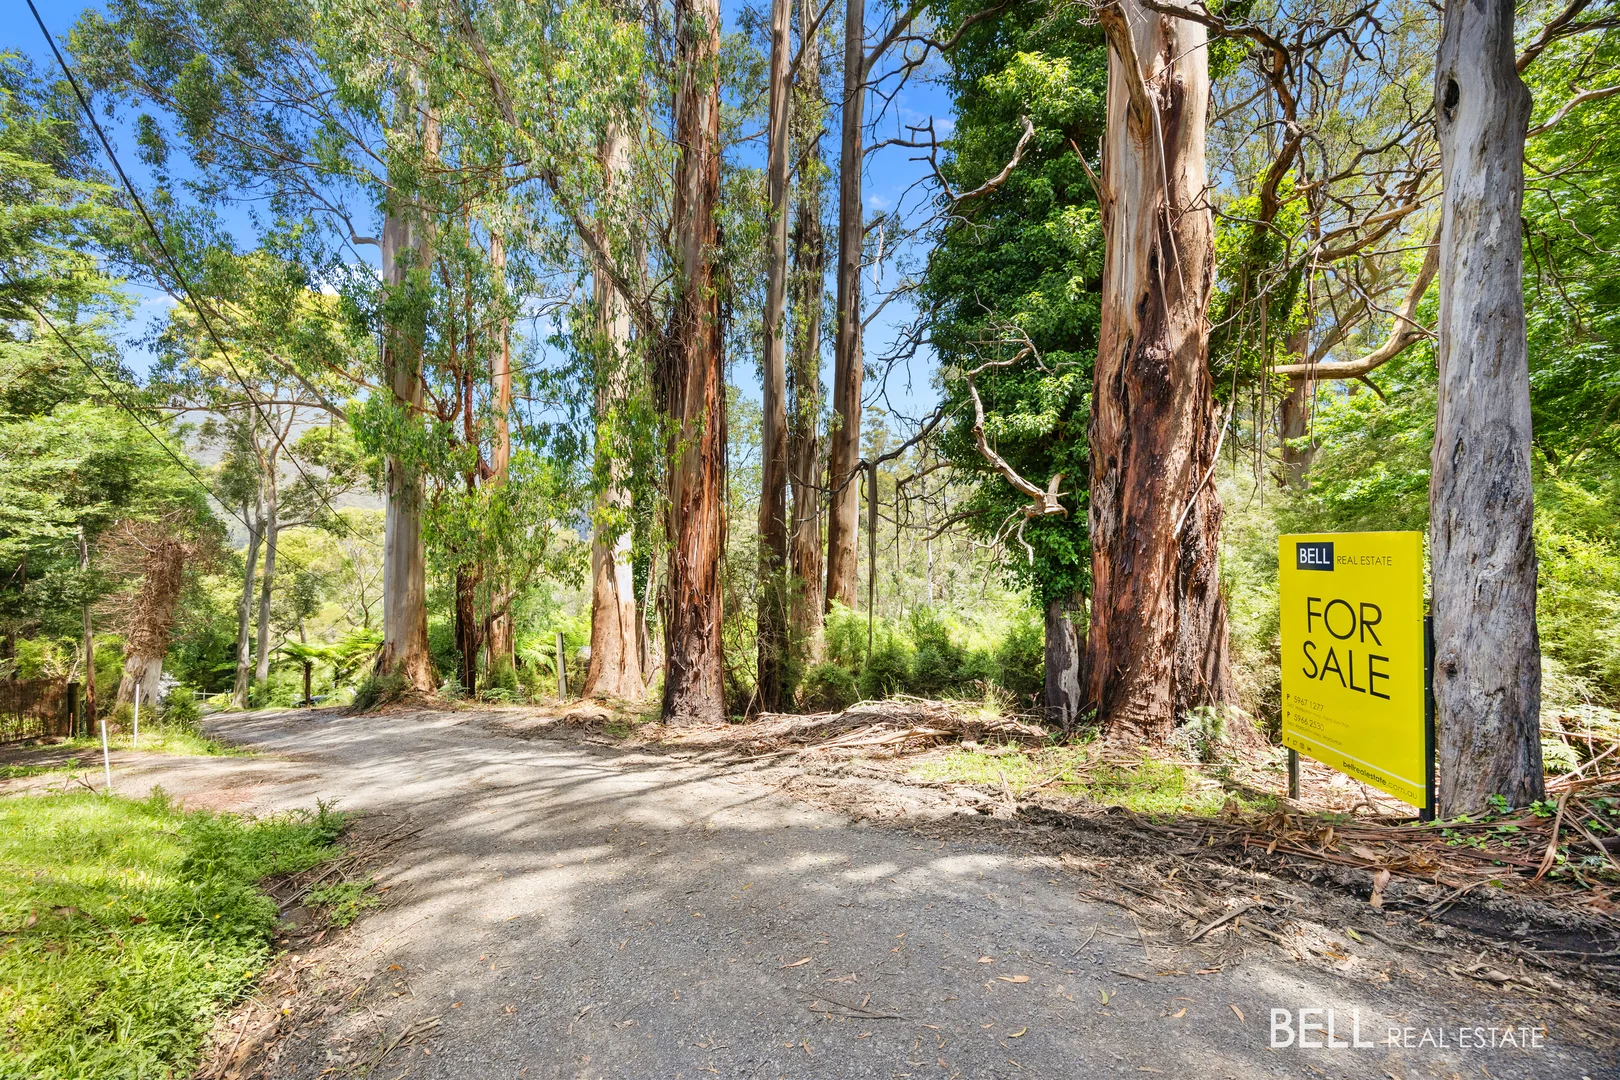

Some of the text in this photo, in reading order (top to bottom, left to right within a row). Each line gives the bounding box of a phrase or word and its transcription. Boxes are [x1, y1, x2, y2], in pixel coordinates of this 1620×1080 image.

[1299, 547, 1392, 566] BELL REAL ESTATE
[1307, 597, 1383, 646] FOR
[1302, 640, 1391, 700] SALE
[1294, 695, 1308, 706] 5967
[1310, 701, 1324, 712] 1277
[1294, 713, 1308, 725] 5966
[1309, 720, 1325, 731] 2530
[1342, 760, 1418, 799] bellrealestate.com.au
